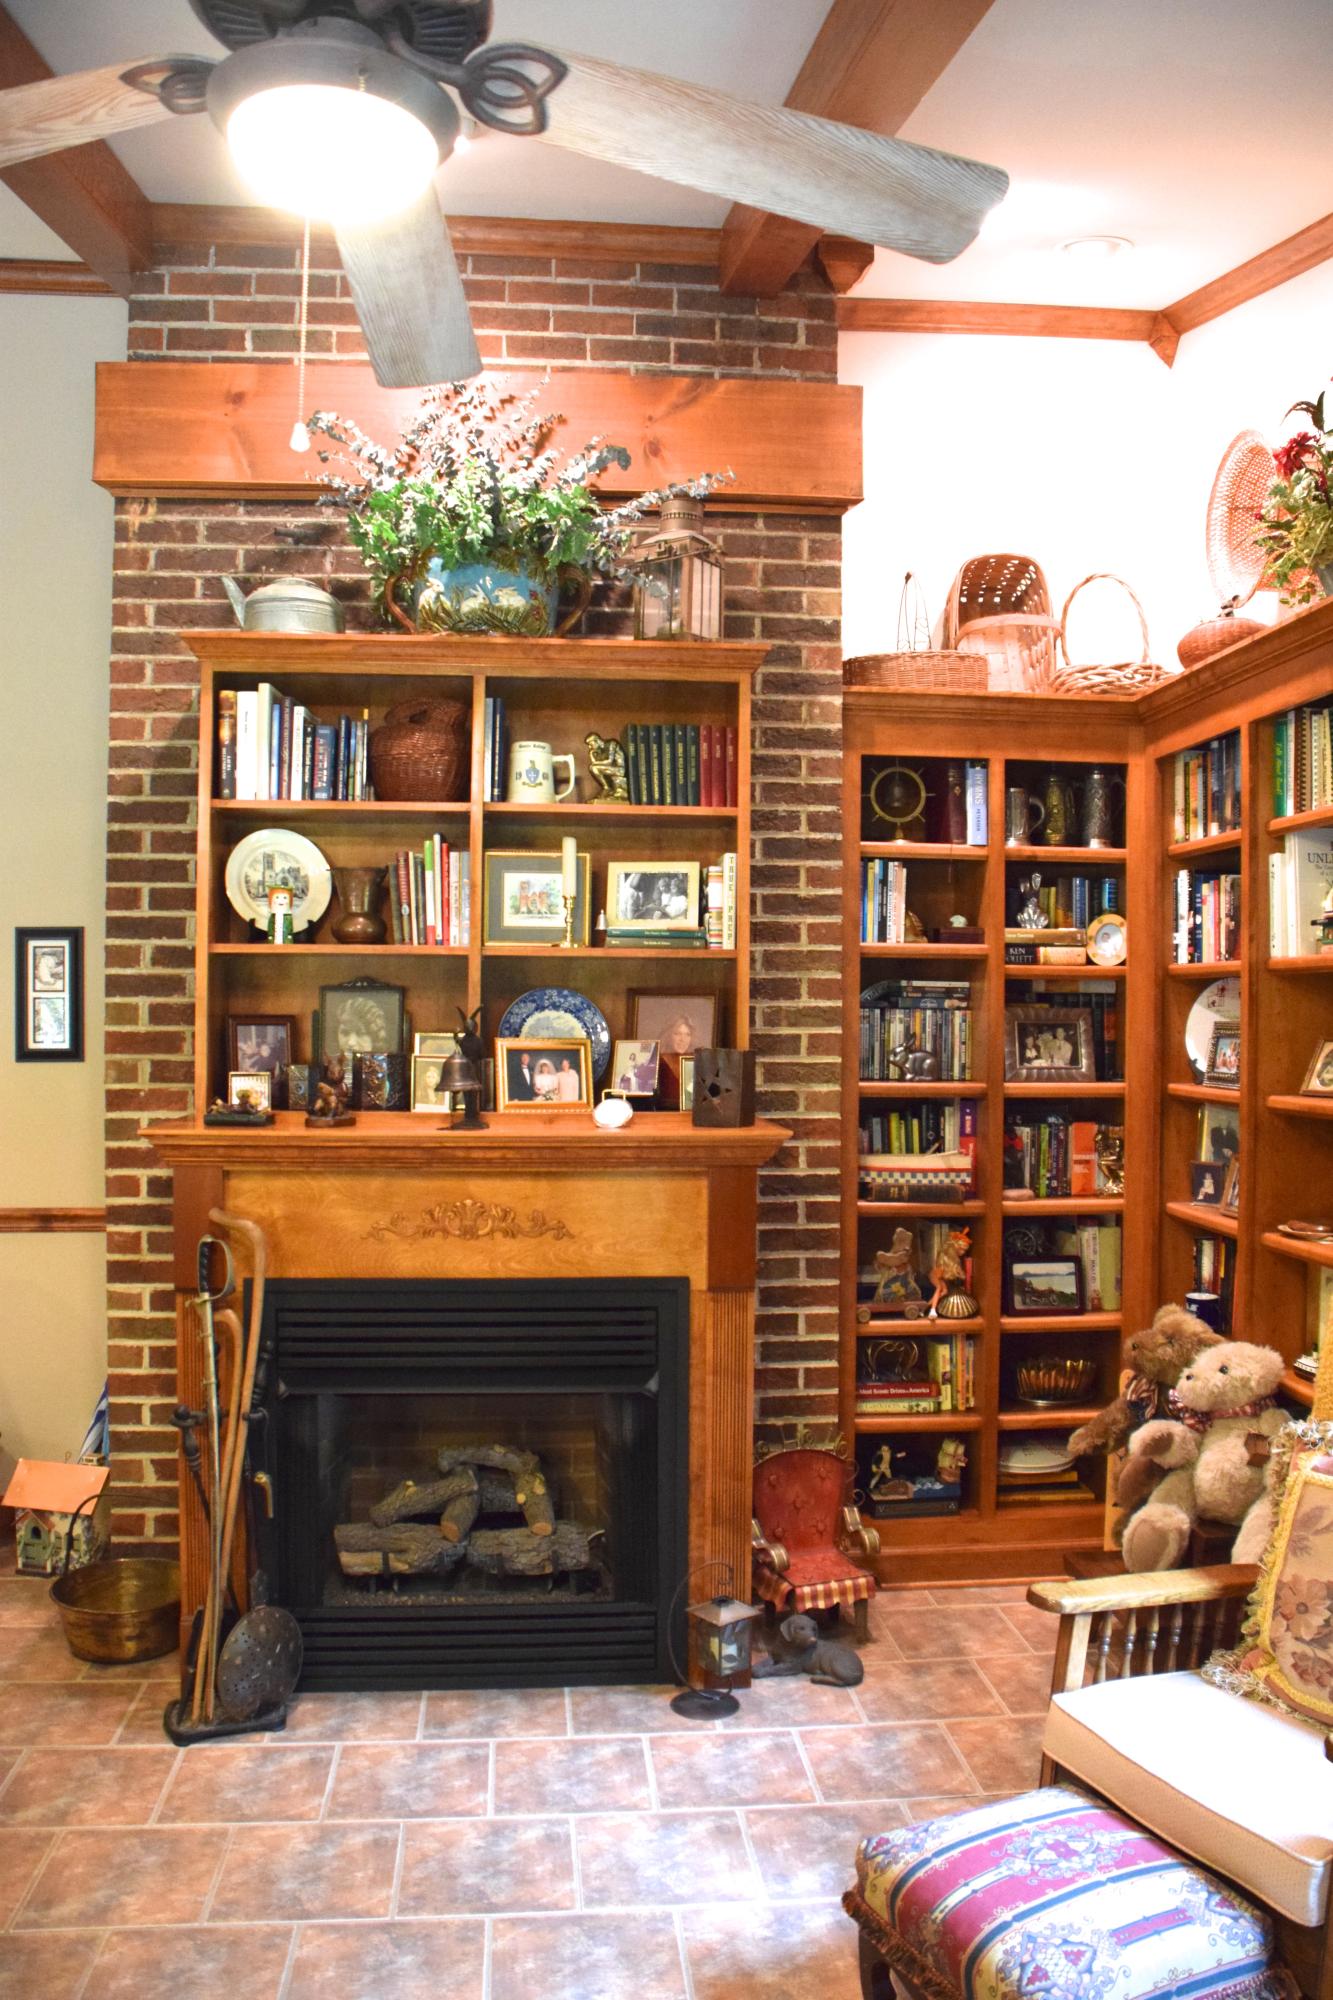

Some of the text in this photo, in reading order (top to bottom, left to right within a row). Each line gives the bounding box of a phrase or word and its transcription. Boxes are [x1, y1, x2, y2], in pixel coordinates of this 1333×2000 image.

[975, 774, 984, 805] HYMNS
[1009, 947, 1026, 955] KEN
[1005, 955, 1033, 964] OLLETT
